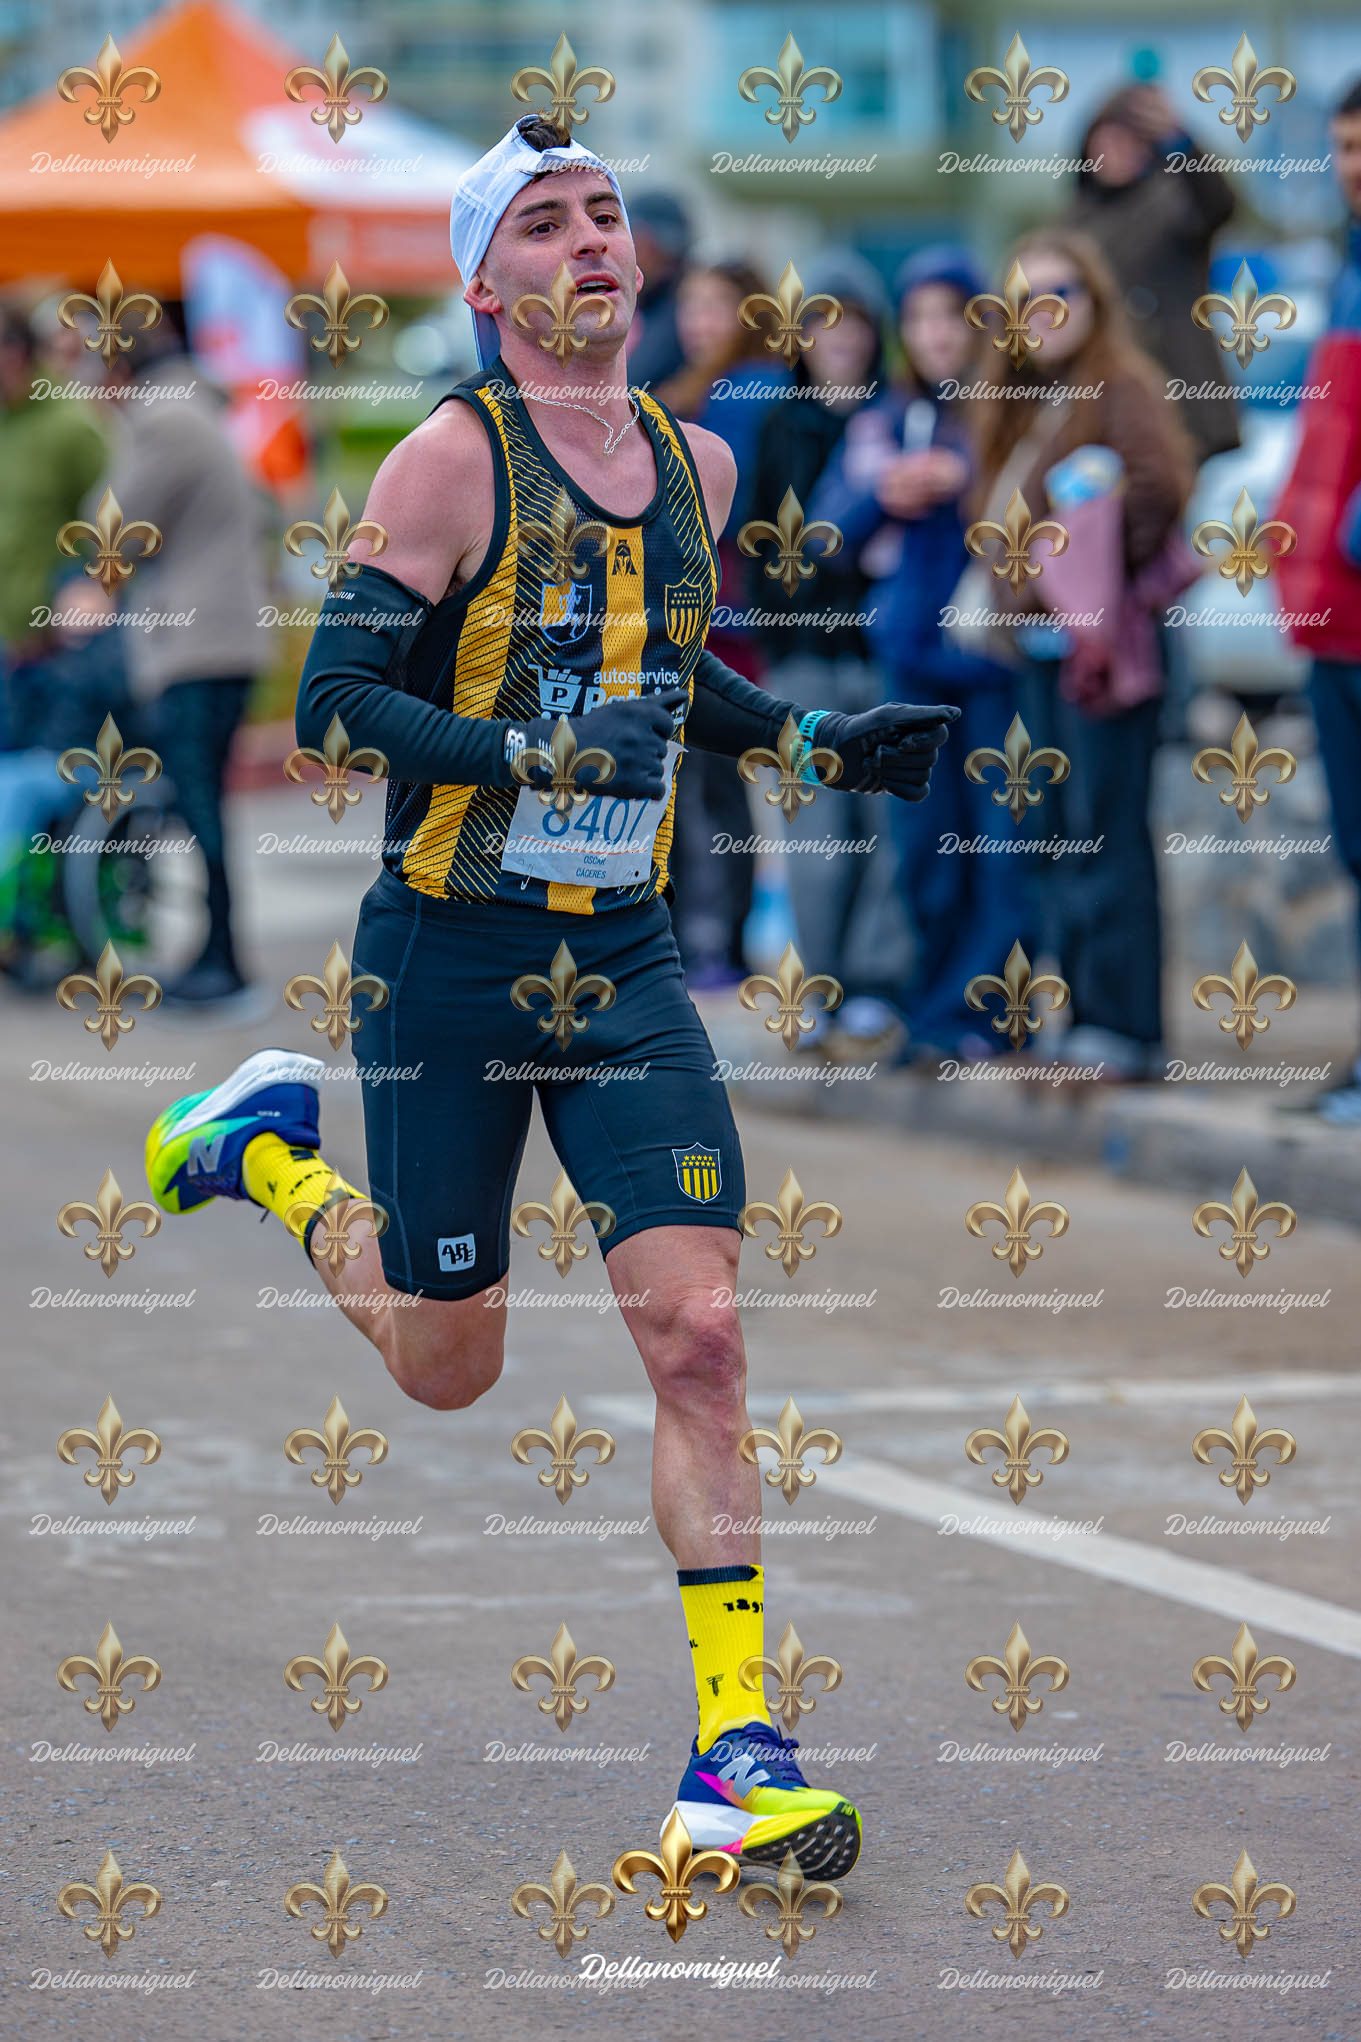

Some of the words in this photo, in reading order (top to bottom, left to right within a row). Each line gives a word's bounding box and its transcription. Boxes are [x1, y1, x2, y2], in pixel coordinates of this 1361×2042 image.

[593, 668, 679, 684] autoservice
[552, 687, 568, 702] P
[583, 855, 607, 865] OSCAR
